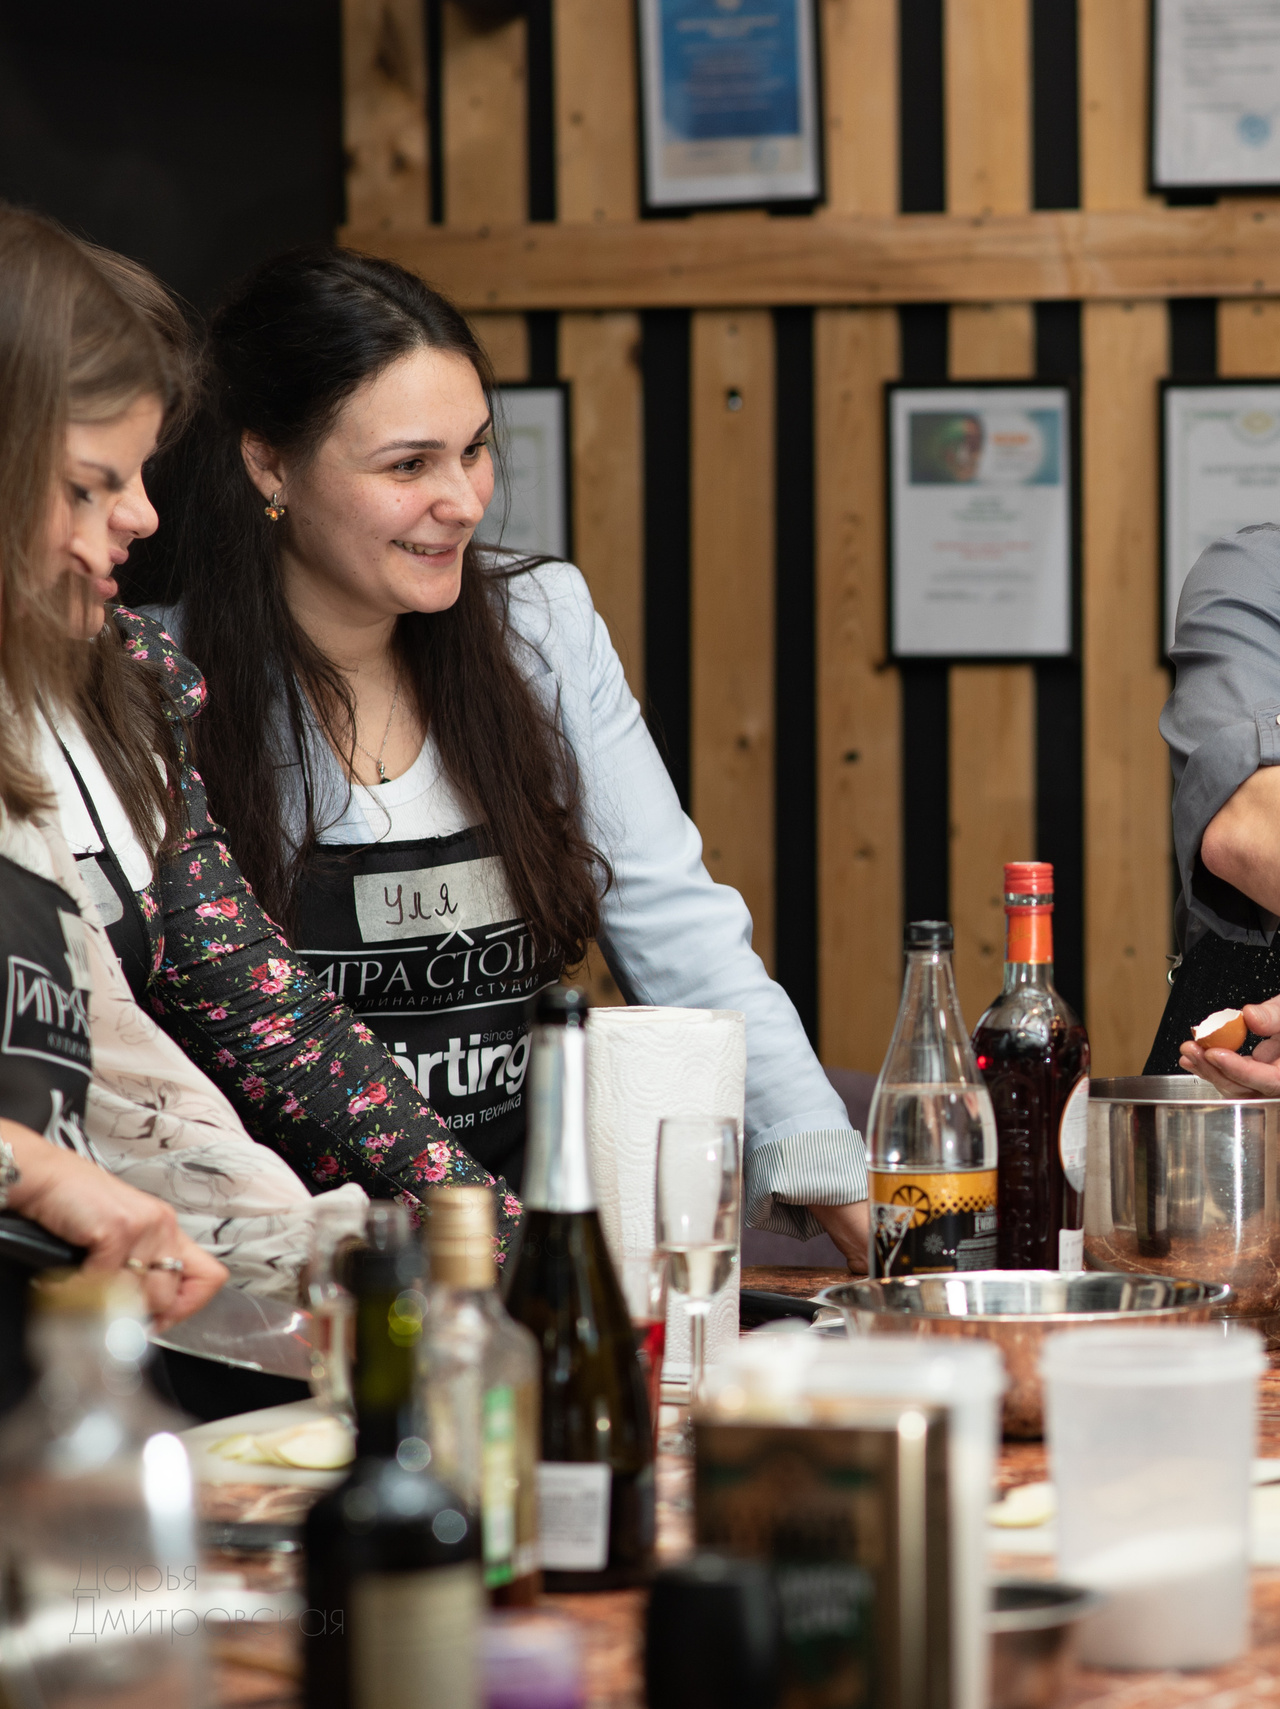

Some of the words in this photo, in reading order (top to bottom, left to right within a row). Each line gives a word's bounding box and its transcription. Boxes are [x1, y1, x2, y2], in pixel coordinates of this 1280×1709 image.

[426, 933, 562, 989] СТОЛ
[16, 969, 91, 1038] ИГРА
[348, 989, 465, 1008] УЛИНАРНАЯ
[475, 973, 539, 997] СТУДИЯ
[482, 1029, 514, 1043] since
[382, 1031, 533, 1099] örting
[479, 1093, 522, 1124] техника
